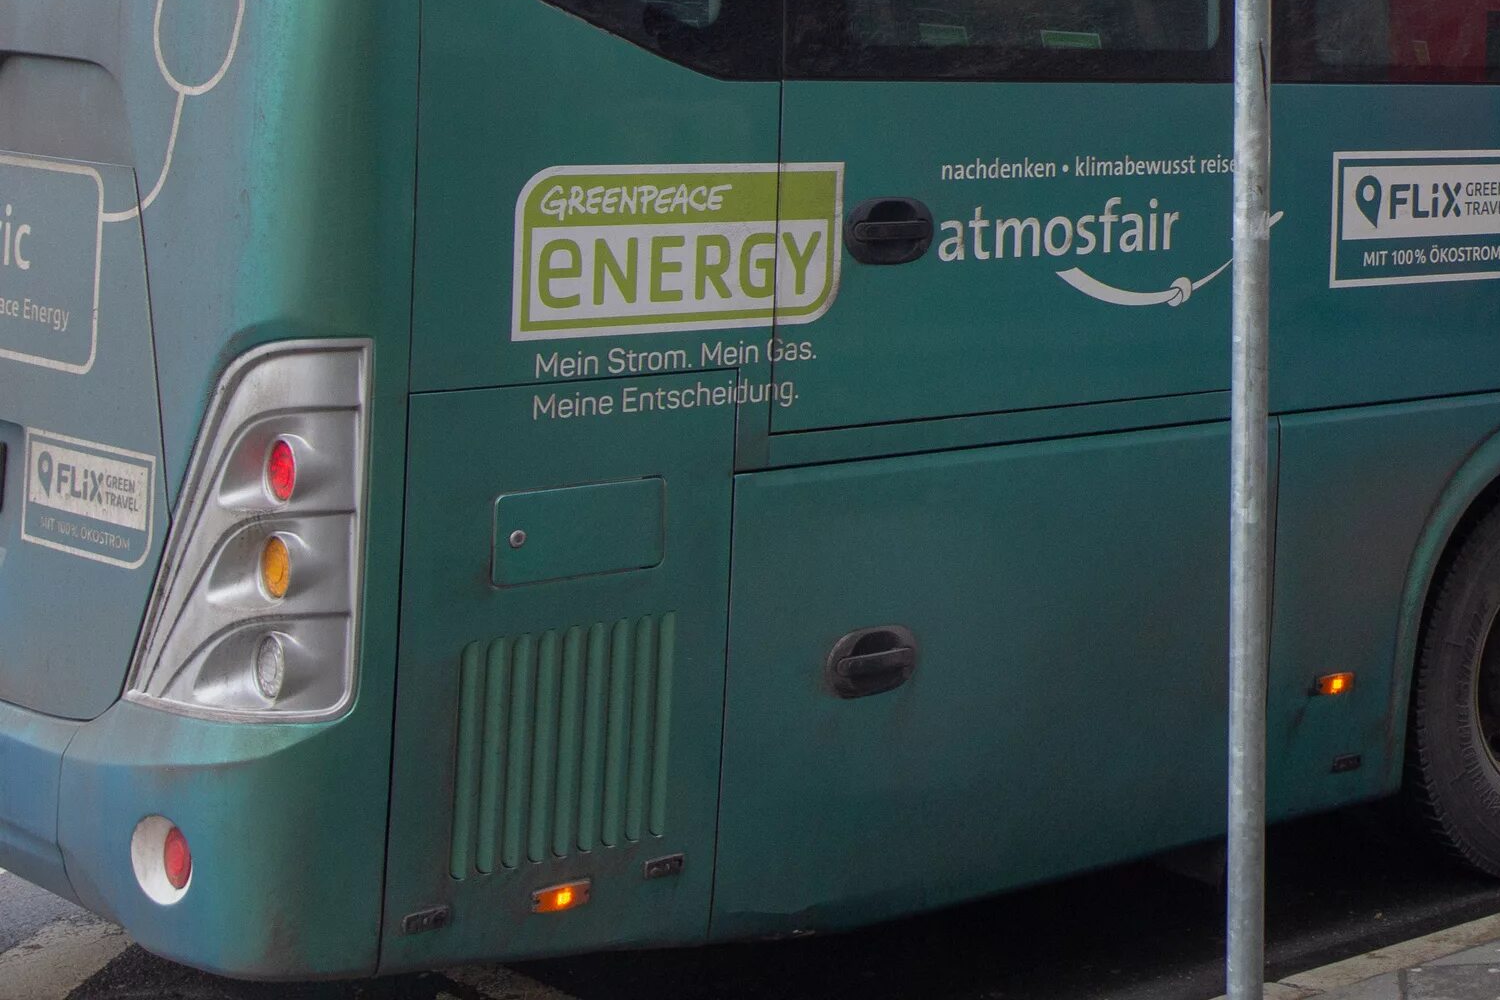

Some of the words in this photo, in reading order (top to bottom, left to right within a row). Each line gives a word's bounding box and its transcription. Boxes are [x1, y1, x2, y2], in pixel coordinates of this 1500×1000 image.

[941, 157, 1056, 181] nachdenken
[1075, 155, 1195, 177] klimabewusst
[1201, 154, 1235, 174] reise
[540, 184, 733, 222] GREENPEACE
[0, 203, 31, 270] ic
[938, 197, 1179, 262] atmosfair
[1363, 251, 1388, 267] MIT
[23, 298, 69, 332] Energy
[535, 351, 598, 379] Mein
[608, 346, 692, 374] Strom.
[701, 340, 759, 367] Mein
[767, 339, 817, 363] Gas.
[533, 391, 613, 420] Meine
[622, 380, 799, 414] Entscheidung.
[104, 491, 139, 512] TRAVEL
[105, 474, 136, 494] GREEN
